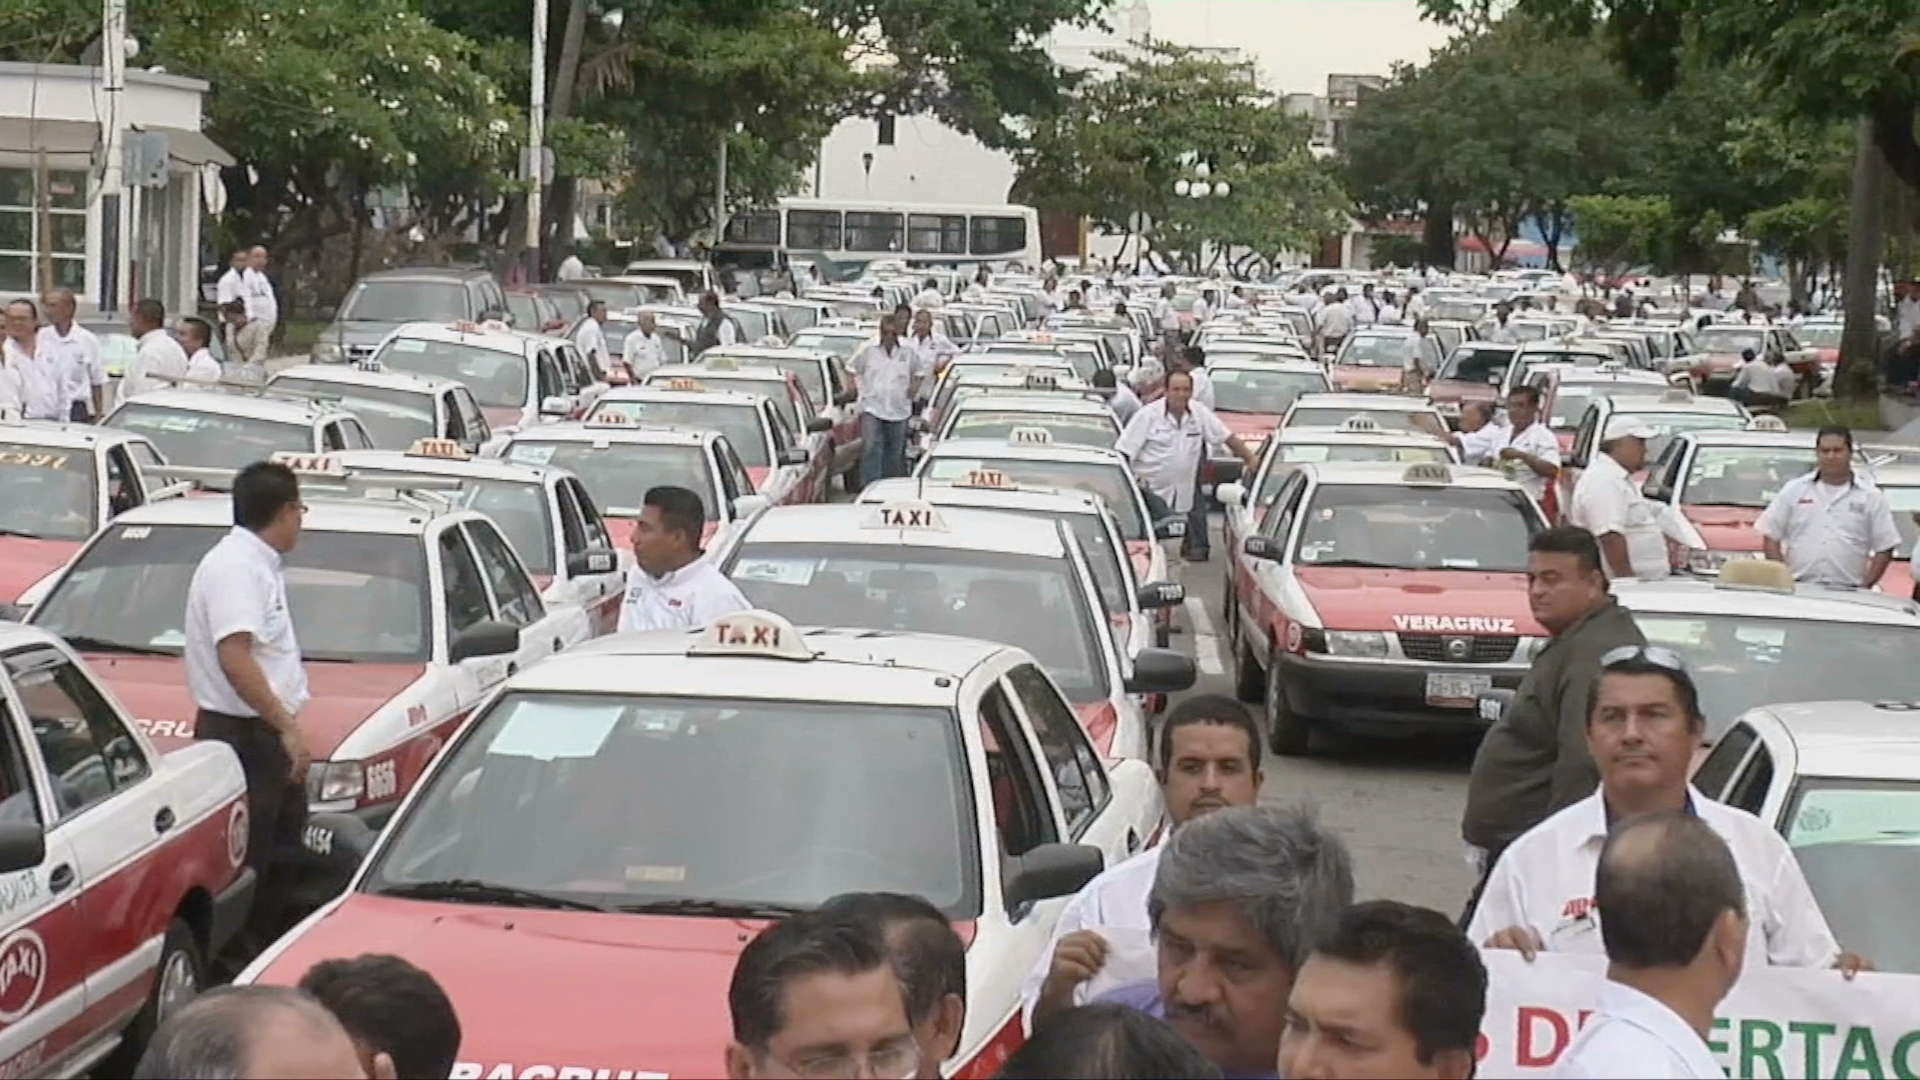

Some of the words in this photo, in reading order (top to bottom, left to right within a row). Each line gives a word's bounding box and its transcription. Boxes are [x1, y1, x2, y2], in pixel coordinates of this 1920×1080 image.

[1016, 431, 1048, 445] TAXI
[421, 442, 454, 456] TAXI
[281, 456, 330, 471] TAXI
[967, 471, 1003, 486] TAXI
[881, 509, 932, 527] TAXI
[1393, 615, 1516, 633] VERACRUZ
[715, 623, 782, 648] TAXI
